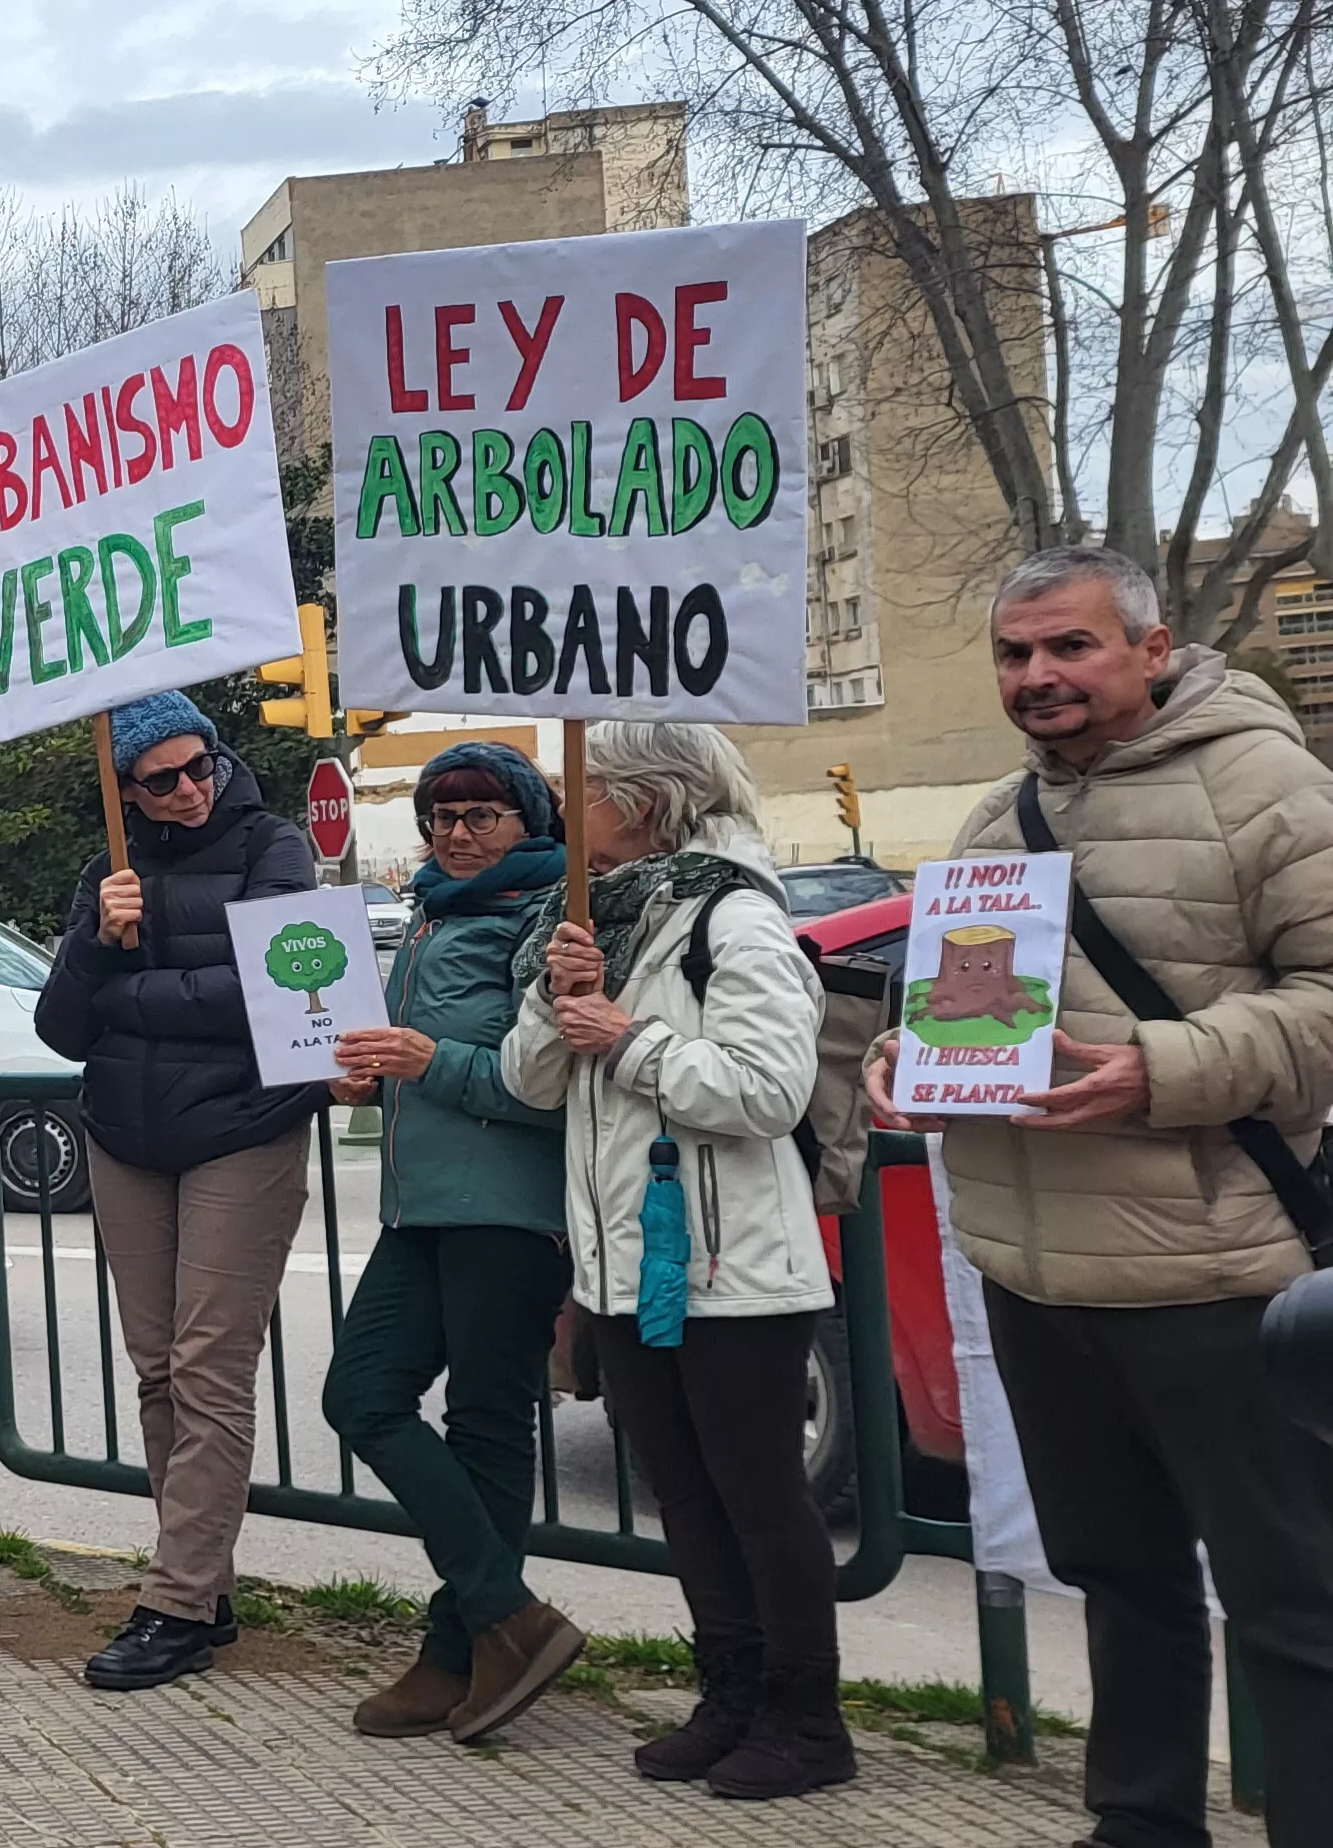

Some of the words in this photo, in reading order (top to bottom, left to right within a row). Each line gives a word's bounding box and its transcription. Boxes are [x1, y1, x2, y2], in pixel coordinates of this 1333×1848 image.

[385, 296, 565, 414] LEY
[614, 280, 729, 404] DE
[355, 411, 779, 539] ARBOLADO
[398, 583, 729, 698] URBANO
[311, 800, 349, 823] STOP
[967, 863, 1026, 889] NO!!
[925, 898, 941, 915] A
[945, 895, 972, 914] LA
[282, 936, 326, 952] VIVOS
[312, 1017, 332, 1028] NO
[291, 1040, 301, 1049] A
[303, 1037, 322, 1047] LA
[935, 1046, 1019, 1066] HUESCA
[911, 1084, 938, 1102] SE
